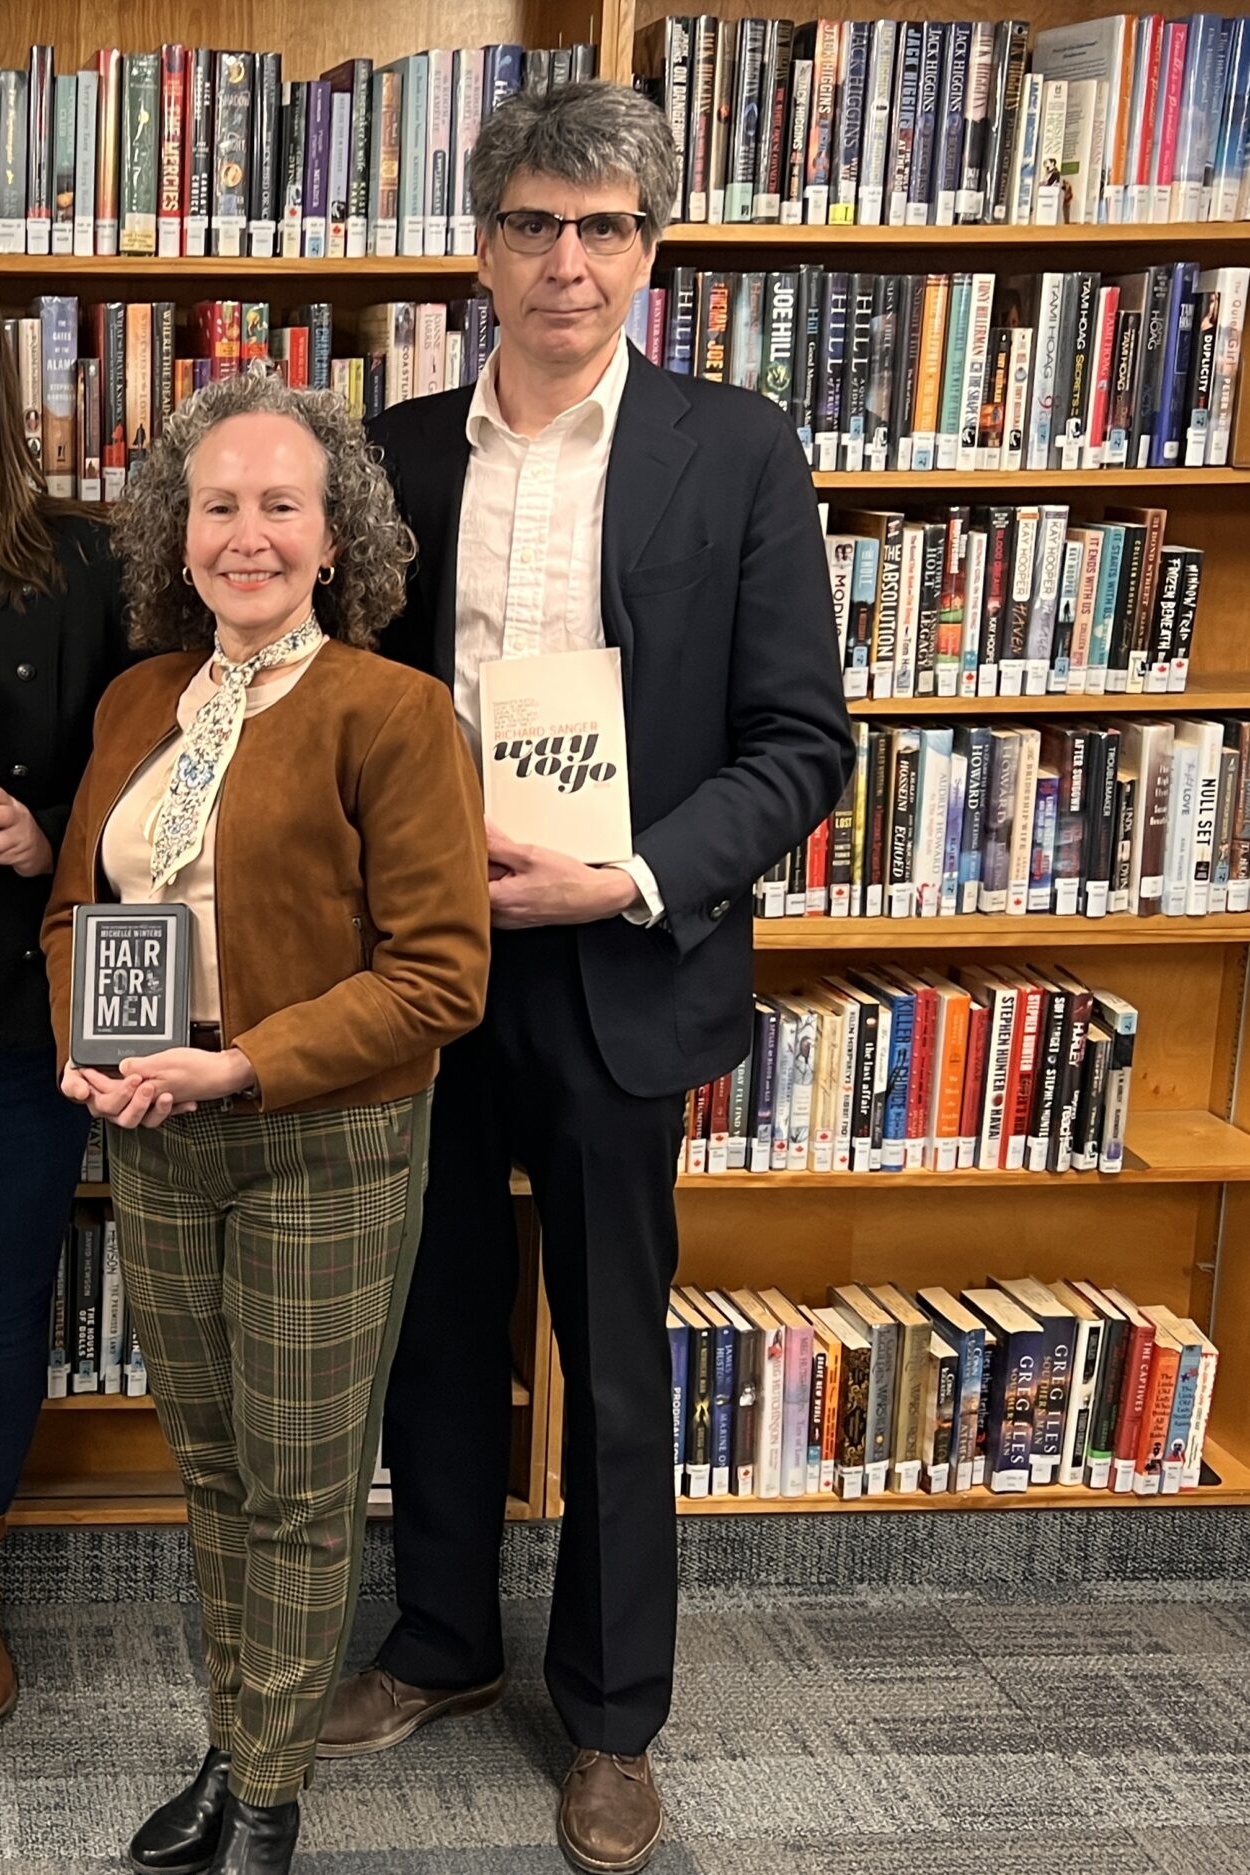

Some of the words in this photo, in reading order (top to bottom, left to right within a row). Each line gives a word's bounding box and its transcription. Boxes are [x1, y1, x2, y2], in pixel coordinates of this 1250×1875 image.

[850, 30, 868, 69] JACK
[905, 29, 921, 66] JACK
[927, 28, 942, 58] JACK
[954, 28, 969, 58] JACK
[898, 72, 916, 129] HIGGINS
[922, 60, 937, 112] HIGGINS
[949, 60, 965, 112] HIGGINS
[792, 106, 805, 150] HIGGINS
[844, 75, 863, 148] HIGGINS
[162, 140, 179, 211] MERCIES
[773, 282, 794, 319] JOE
[978, 280, 991, 301] TONY
[1049, 281, 1060, 322] TAMI
[1081, 280, 1091, 309] TAMI
[163, 309, 171, 352] WHERE
[676, 291, 693, 358] HILL
[770, 323, 792, 362] HILL
[827, 294, 847, 373] HILL
[852, 295, 872, 372] HILL
[973, 306, 988, 356] HILLERMAN
[1076, 311, 1088, 350] HOAG
[1121, 330, 1130, 355] TAMI
[706, 340, 724, 369] JOE
[1043, 326, 1055, 379] HOAG
[1199, 334, 1213, 393] DUPLICITY
[1117, 357, 1128, 391] HOAG
[162, 381, 171, 411] DEAD
[1021, 522, 1030, 545] KAY
[1050, 521, 1059, 544] KAY
[884, 544, 901, 561] THE
[925, 548, 936, 589] HOLT
[1016, 548, 1029, 596] HOOPER
[1043, 547, 1056, 594] HOOPER
[1086, 549, 1097, 574] ENDS
[1108, 545, 1120, 578] STARTS
[1131, 540, 1142, 577] COLLEEN
[1083, 576, 1095, 600] WITH
[1105, 581, 1116, 605] WITH
[1142, 563, 1153, 606] STREET
[1163, 558, 1181, 598] FROZEN
[1183, 564, 1199, 607] MINNOW
[877, 562, 900, 657] ABSOLUTION
[1011, 604, 1028, 654] HAVEN
[1157, 601, 1176, 649] BENEATH
[1179, 611, 1194, 641] TRAP
[918, 611, 931, 668] LEGACY
[493, 733, 599, 763] way
[494, 724, 544, 741] RICHARD
[550, 721, 598, 736] SANGER
[1073, 739, 1084, 766] AFTER
[558, 759, 617, 794] go
[897, 760, 909, 812] HOSSEINI
[936, 773, 948, 818] AUDREY
[968, 744, 983, 809] HOWARD
[997, 745, 1012, 824] HOWARD
[1070, 769, 1083, 812] SUNDOWN
[1102, 746, 1116, 817] TROUBLEMAKER
[1199, 779, 1216, 815] NULL
[835, 817, 852, 829] LOST
[1196, 820, 1212, 846] SET
[892, 826, 906, 878] ECHOED
[932, 822, 944, 875] HOWARD
[101, 929, 131, 937] MICHELLE
[99, 940, 160, 967] HAIR
[98, 969, 145, 995] FOR
[97, 996, 158, 1026] MEN
[894, 1000, 915, 1043] KILLER
[997, 996, 1014, 1046] STEPHEN
[1024, 994, 1041, 1033] STEPHEN
[1019, 1035, 1036, 1071] HUNTER
[1069, 1022, 1084, 1067] HURLEY
[862, 1061, 873, 1082] last
[993, 1049, 1009, 1092] HUNTER
[1043, 1069, 1057, 1108] STEPHEN
[860, 1084, 871, 1116] affair
[106, 1230, 119, 1275] HEWSON
[84, 1260, 92, 1296] HEWSON
[78, 1326, 86, 1356] DOLLS
[725, 1345, 733, 1373] JAMES
[1142, 1342, 1152, 1360] THE
[816, 1356, 824, 1378] BRAVE
[1016, 1356, 1034, 1411] GREG
[1038, 1356, 1051, 1415] SOUTHERN
[1050, 1345, 1068, 1400] GREG
[1006, 1368, 1018, 1427] SOUTHERN
[1135, 1364, 1148, 1412] CAPTIVES
[770, 1380, 781, 1444] HUTCHINSON
[814, 1399, 822, 1423] WORLD
[719, 1413, 727, 1451] MARINE
[1010, 1422, 1028, 1463] ILES
[1034, 1421, 1045, 1445] MAN
[1044, 1411, 1062, 1453] ILES
